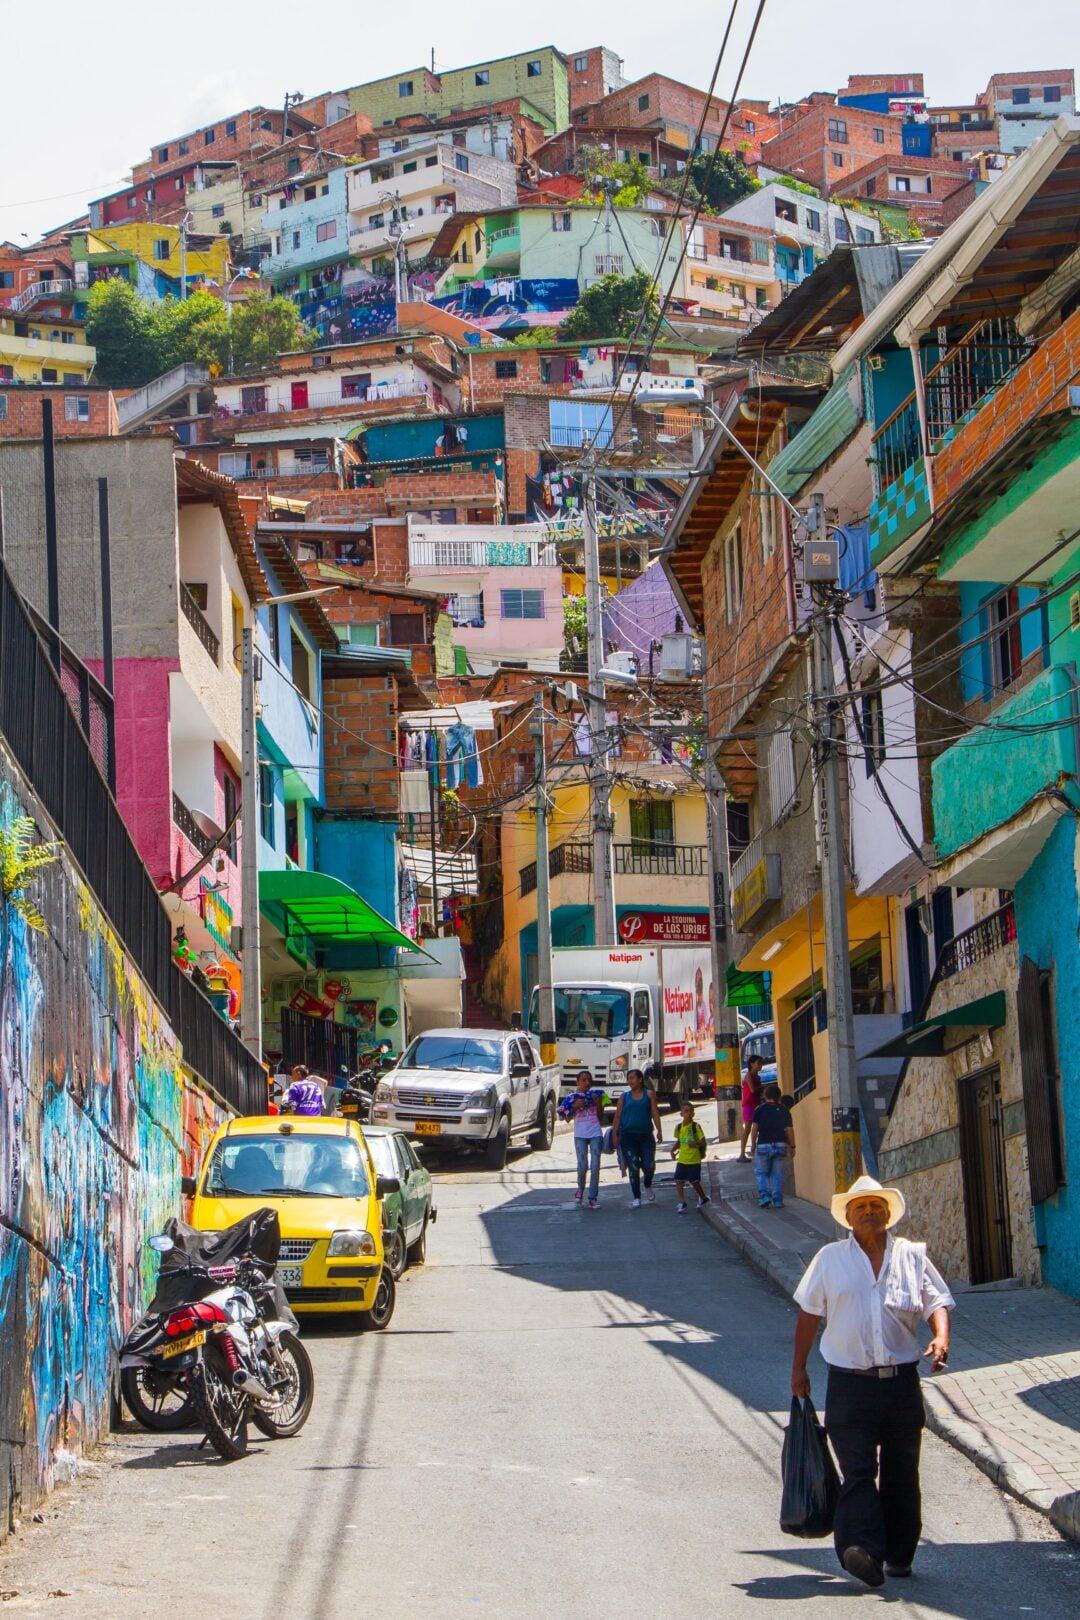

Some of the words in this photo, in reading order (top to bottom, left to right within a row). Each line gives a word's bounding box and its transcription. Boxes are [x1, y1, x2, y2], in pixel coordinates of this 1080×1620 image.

[672, 916, 696, 924] ESQUINA
[653, 923, 664, 933] DE
[666, 923, 681, 933] LOS
[683, 924, 707, 934] URIBE
[609, 953, 642, 963] Natipan
[664, 986, 694, 1019] Natipan
[282, 1269, 301, 1282] 336
